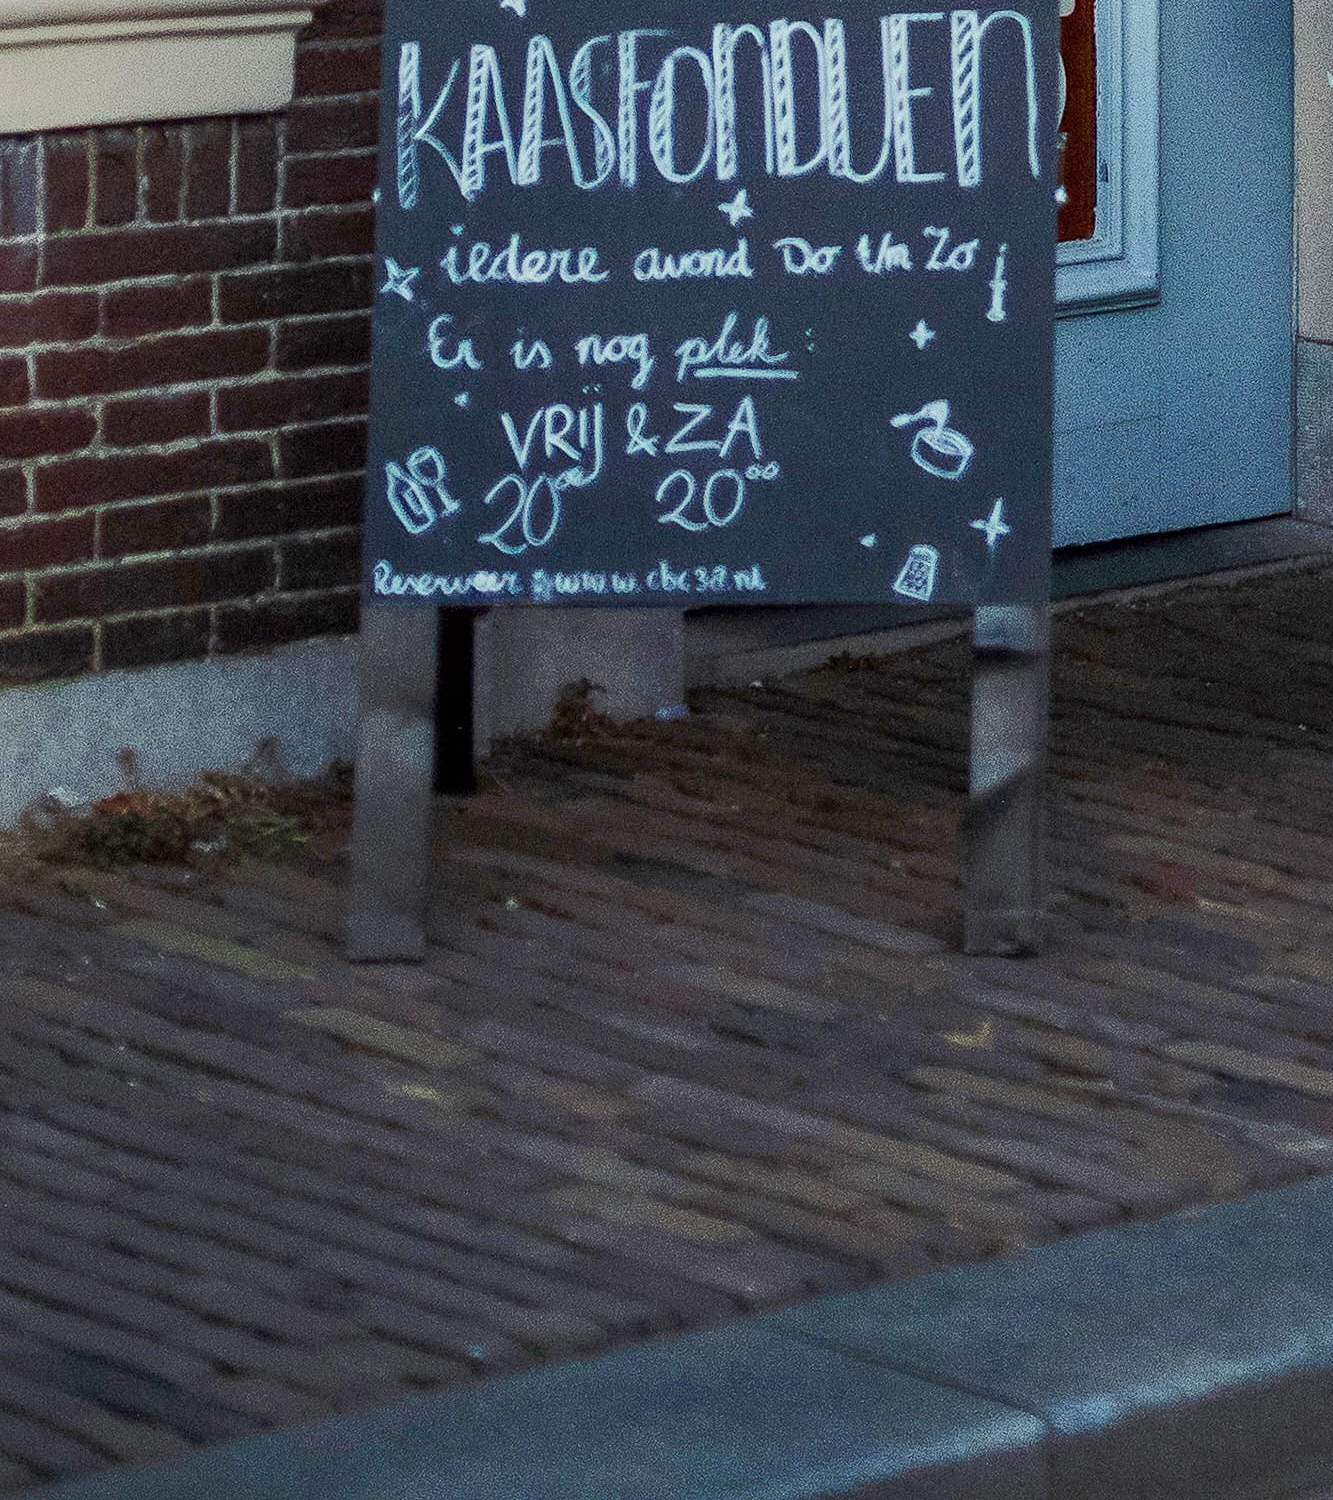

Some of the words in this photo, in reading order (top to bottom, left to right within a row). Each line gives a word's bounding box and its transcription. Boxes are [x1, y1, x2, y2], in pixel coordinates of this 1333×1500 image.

[440, 225, 608, 283] iedere
[632, 238, 753, 280] avond
[772, 237, 841, 274] Do
[924, 227, 978, 272] Zo
[427, 314, 483, 370] Er
[510, 326, 552, 371] is
[575, 333, 653, 390] nog
[625, 402, 660, 456] &
[664, 395, 762, 459] ZA
